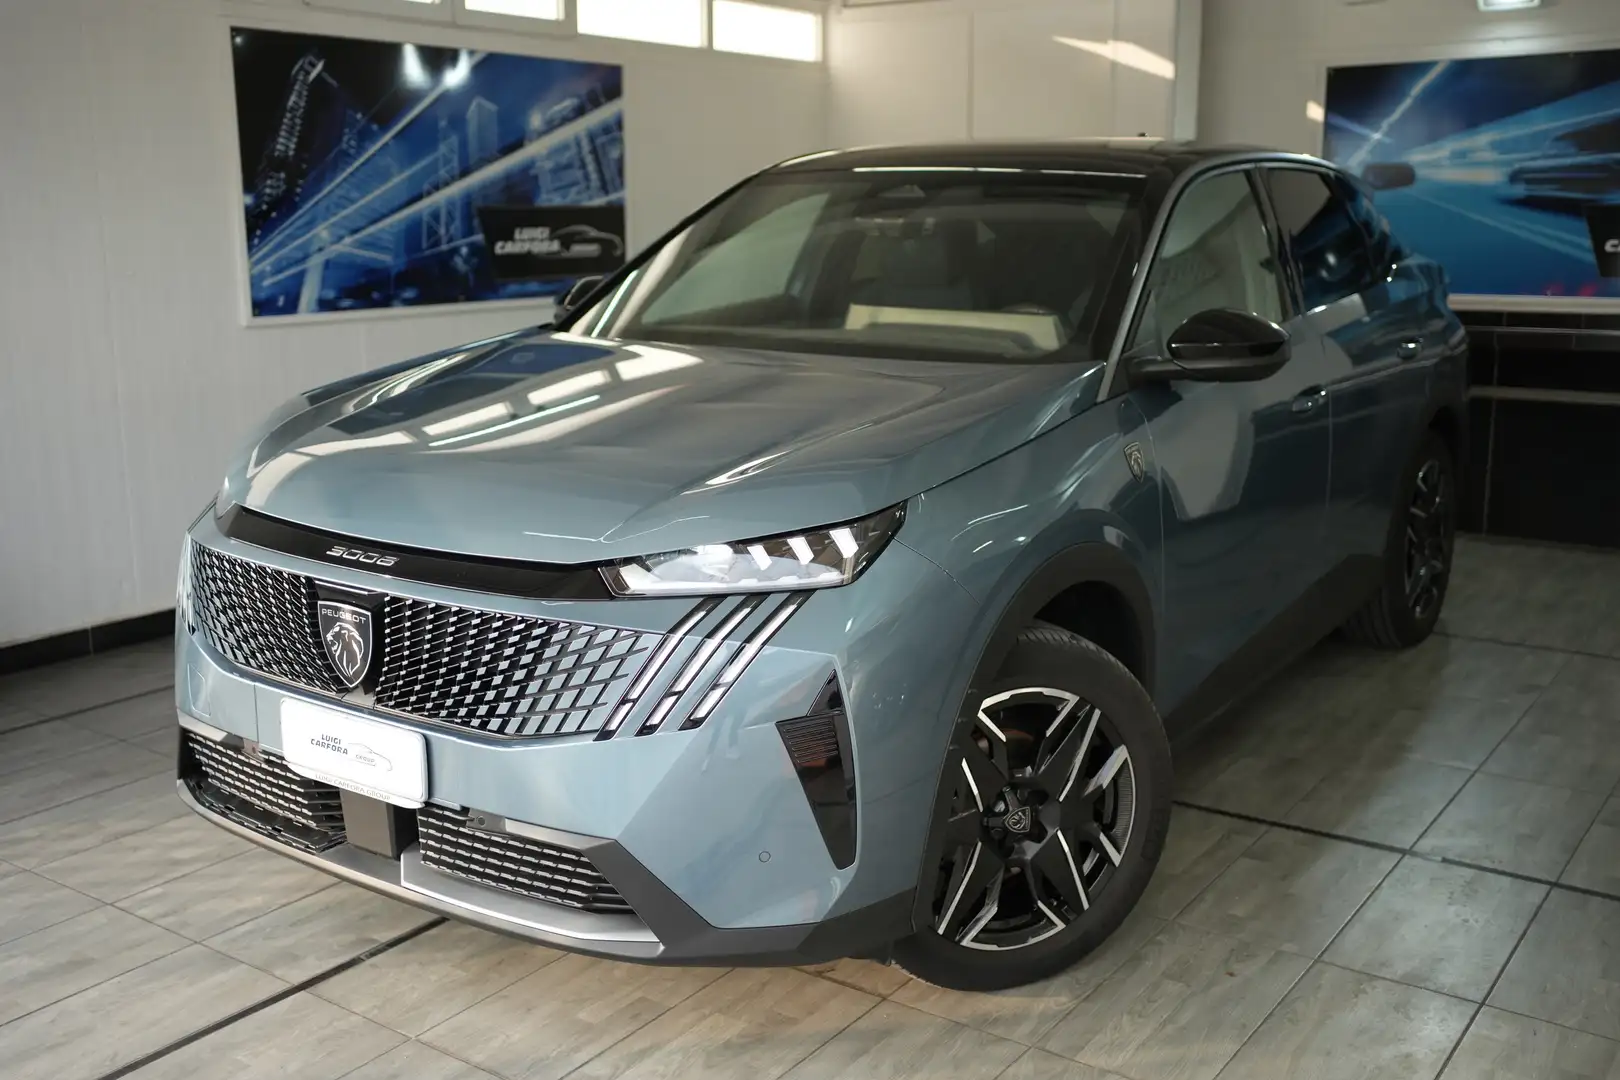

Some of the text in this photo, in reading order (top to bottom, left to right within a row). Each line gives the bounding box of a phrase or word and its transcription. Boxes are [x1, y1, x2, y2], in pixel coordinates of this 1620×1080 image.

[326, 545, 399, 567] 3008
[321, 608, 367, 625] PEUGEOT
[310, 738, 348, 755] CARFORA
[321, 733, 342, 745] LUIGI
[333, 779, 365, 793] CARFORA
[366, 789, 391, 800] GROUP
